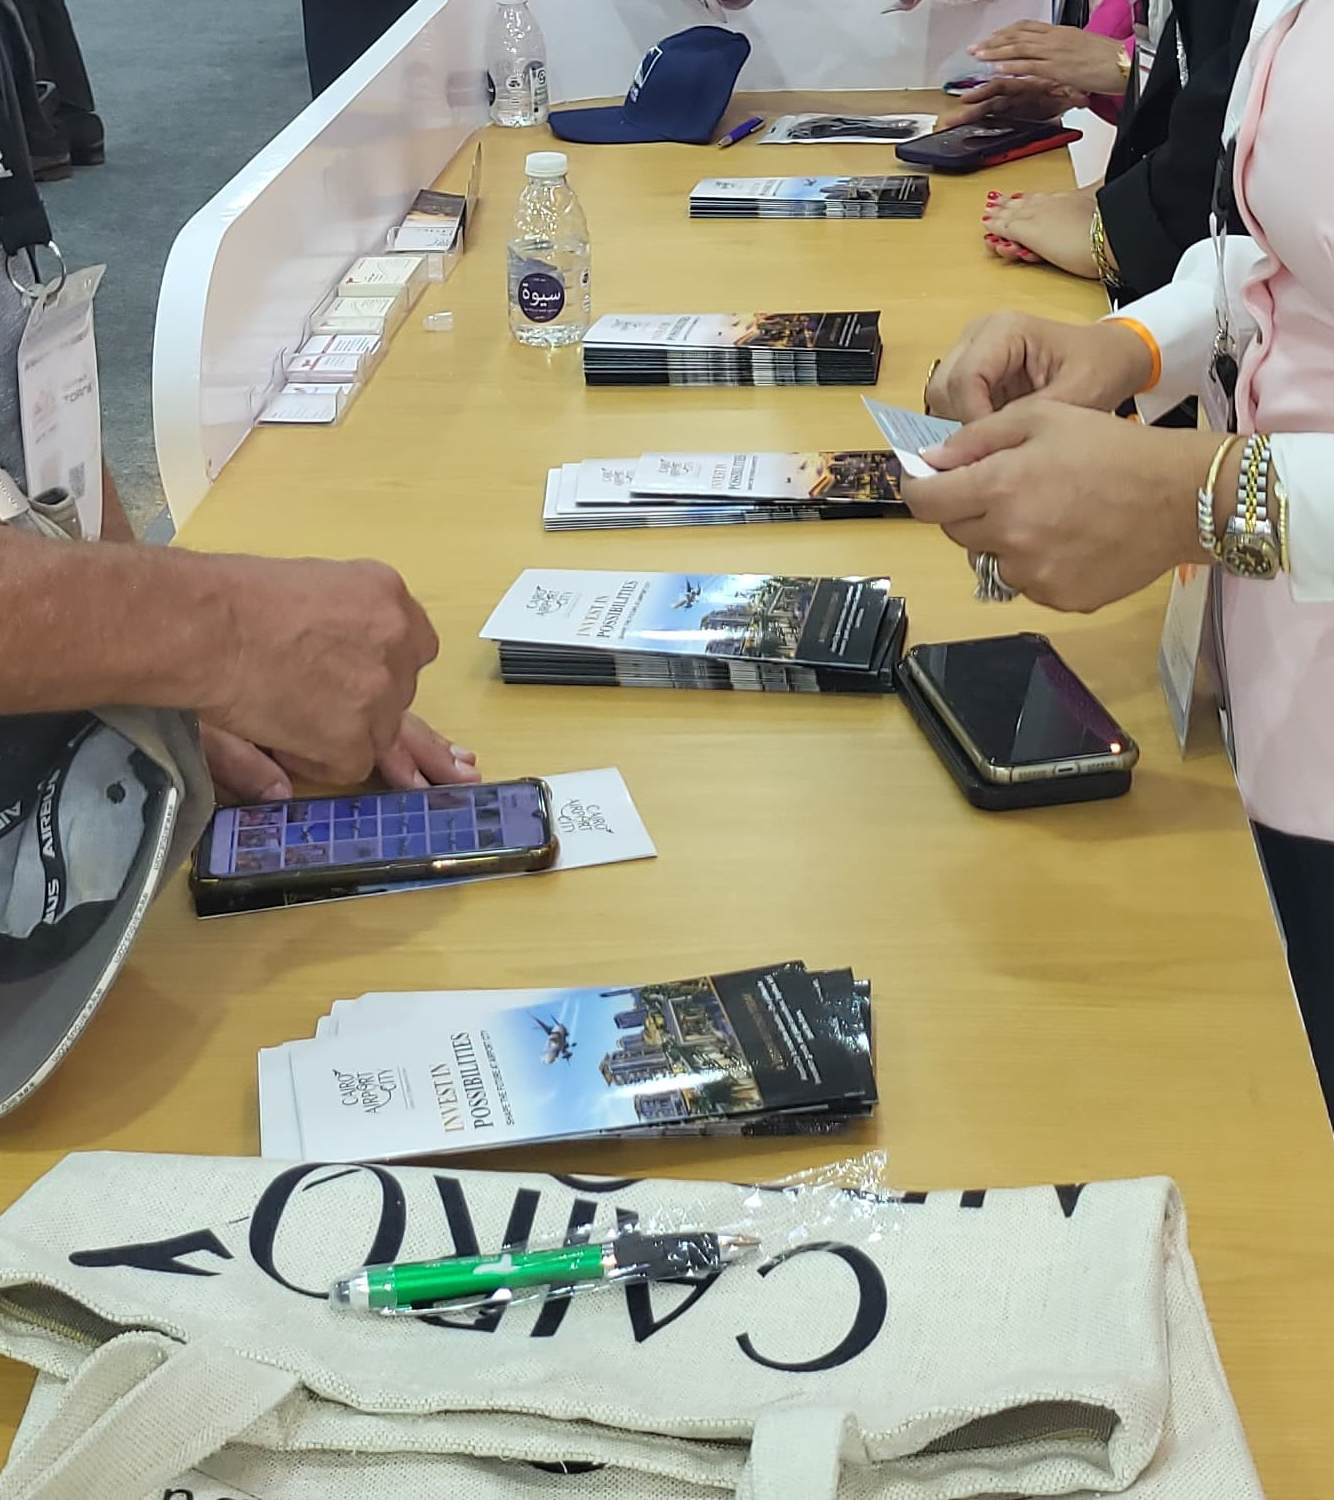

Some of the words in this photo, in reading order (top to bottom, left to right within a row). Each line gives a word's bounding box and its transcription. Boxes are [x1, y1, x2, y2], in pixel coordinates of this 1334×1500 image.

[522, 282, 561, 307] سيوة
[597, 580, 640, 638] POSSIBILITIES
[337, 1071, 359, 1106] CAIRO
[377, 1068, 398, 1092] CITY
[429, 1061, 452, 1079] IN
[450, 1031, 495, 1130] POSSIBILITIES
[355, 1070, 380, 1114] AIRPORT
[433, 1080, 465, 1133] INVEST
